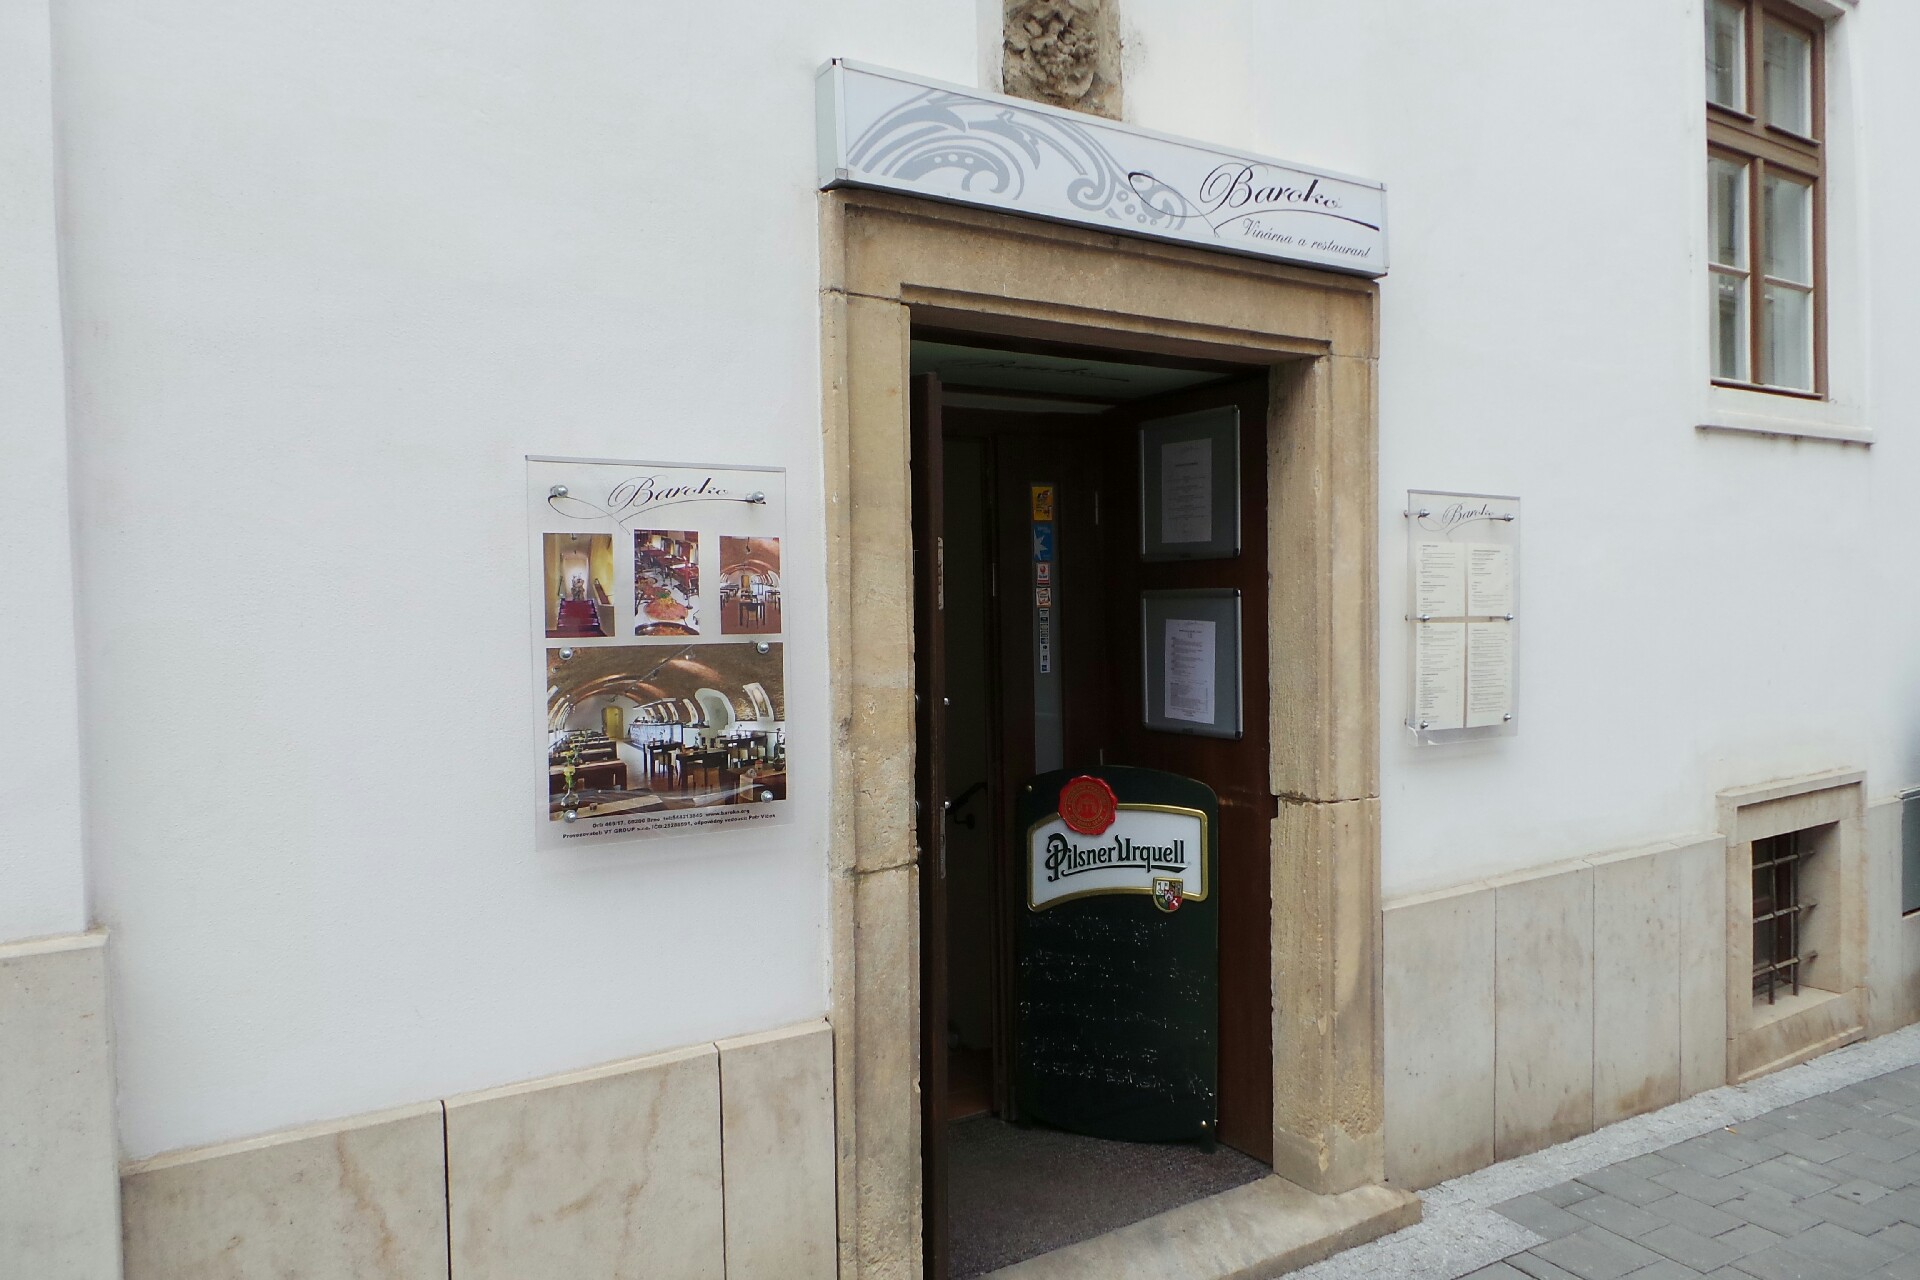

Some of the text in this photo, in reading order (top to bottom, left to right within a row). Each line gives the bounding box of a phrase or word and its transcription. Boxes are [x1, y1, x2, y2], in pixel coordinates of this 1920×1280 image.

[1199, 162, 1344, 209] Baroko
[1242, 217, 1372, 259] Vinárna a restaurant
[607, 474, 729, 508] Baroko
[1045, 832, 1186, 882] Pilsner Urquell
